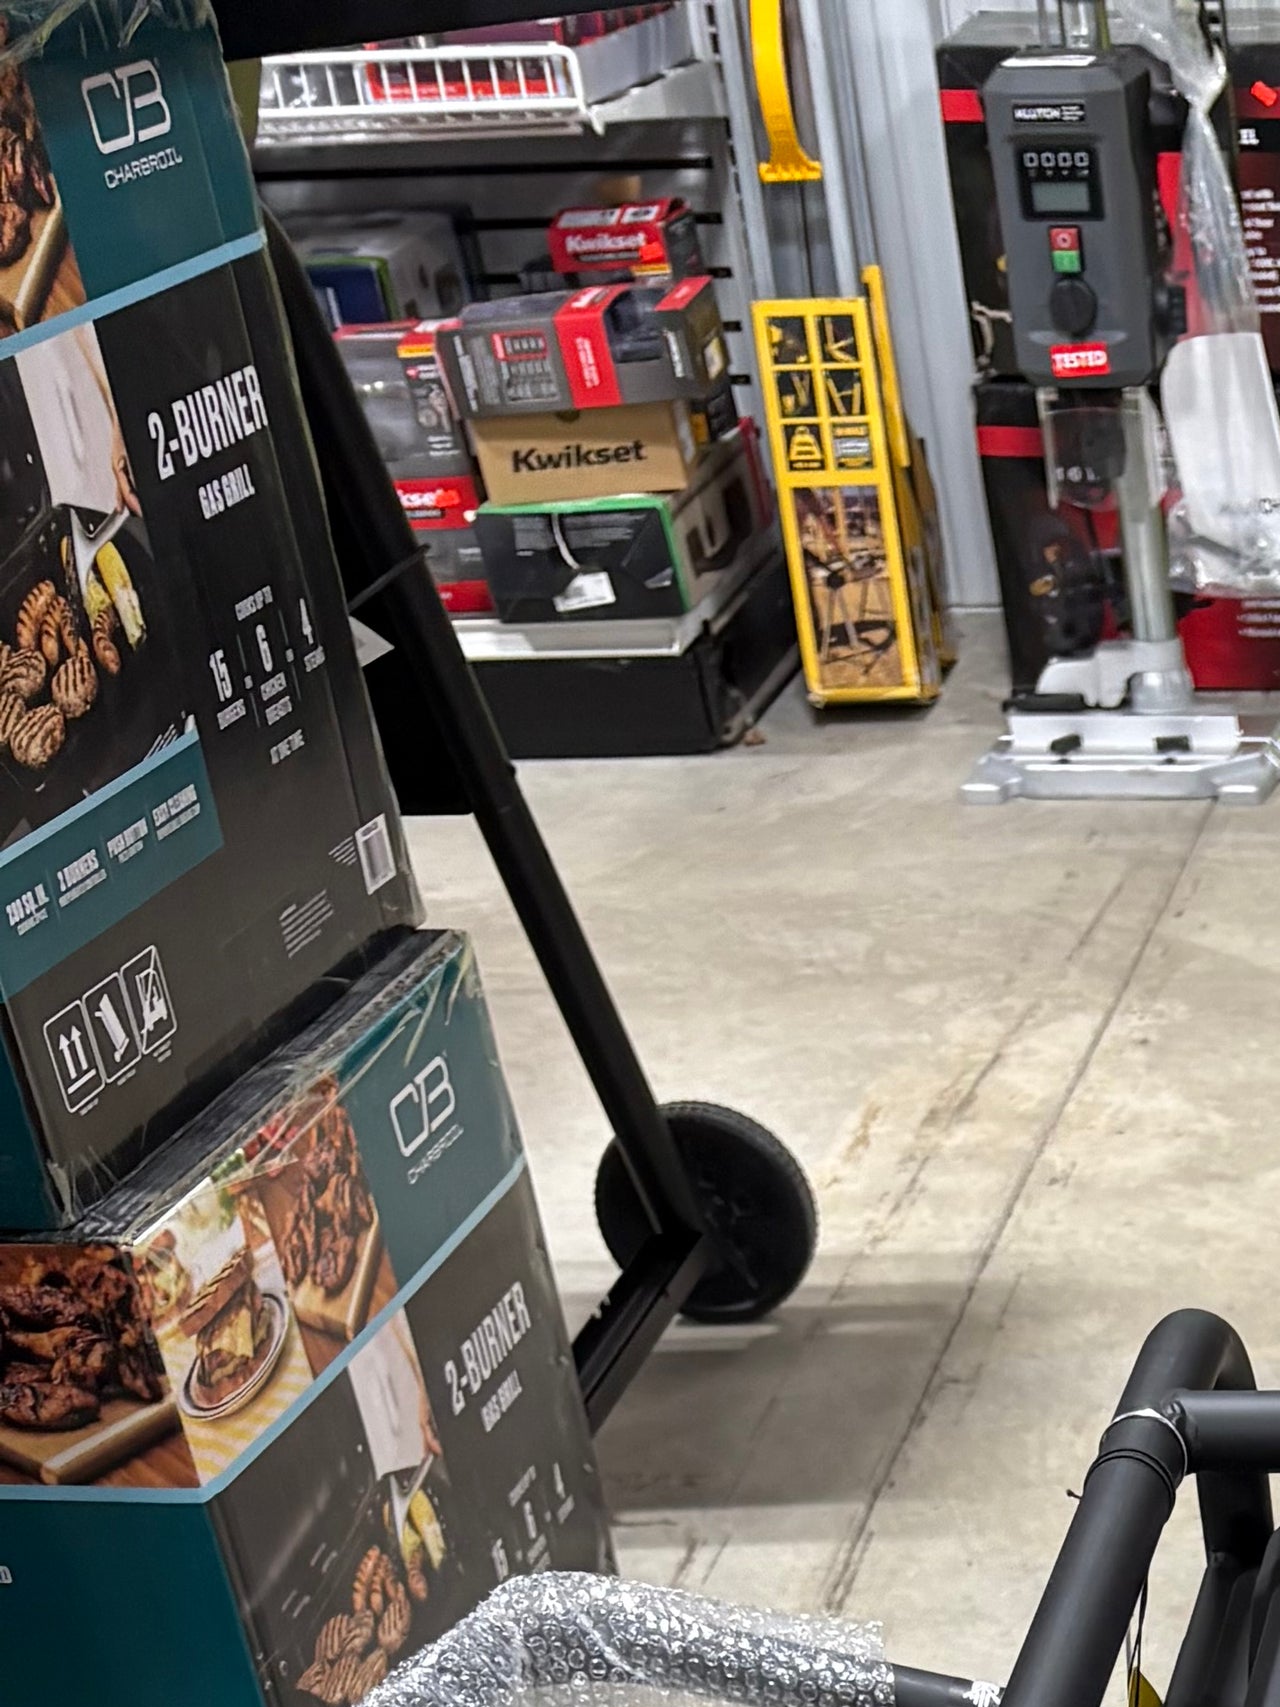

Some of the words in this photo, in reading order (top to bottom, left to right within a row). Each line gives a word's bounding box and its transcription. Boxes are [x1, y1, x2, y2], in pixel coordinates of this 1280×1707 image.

[104, 147, 183, 189] CHARBROIL
[565, 232, 646, 255] Kwikset
[1053, 349, 1108, 372] TESTED
[147, 365, 269, 481] 2-BURNER
[512, 439, 647, 473] Kwikset
[199, 479, 221, 520] GAS
[221, 463, 256, 507] GRILL
[255, 624, 273, 672] 6
[209, 649, 233, 702] 15
[444, 1281, 532, 1416] 2-BURNER
